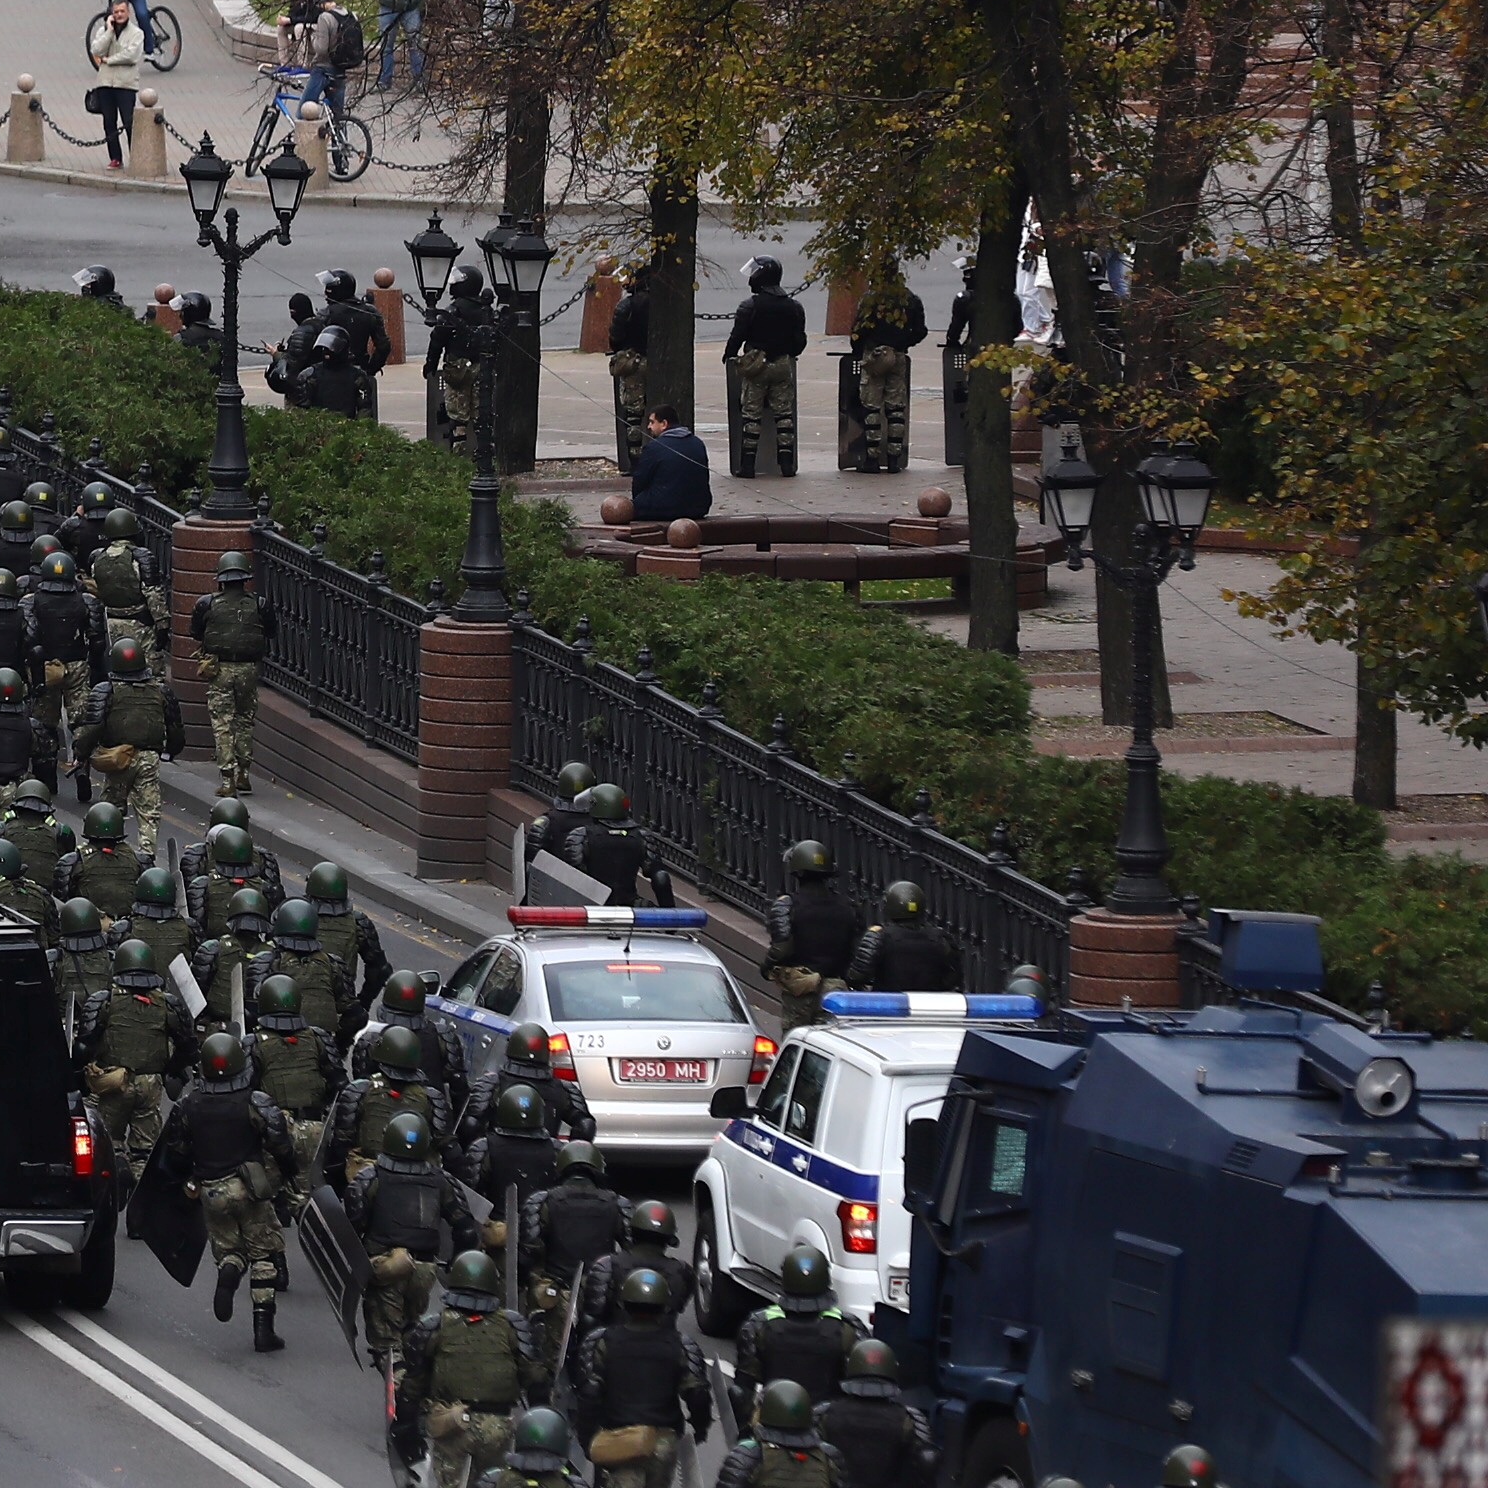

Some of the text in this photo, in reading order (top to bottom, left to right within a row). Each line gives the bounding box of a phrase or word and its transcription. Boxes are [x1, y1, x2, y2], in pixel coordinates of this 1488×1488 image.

[578, 1034, 605, 1048] 723
[626, 1062, 701, 1078] 2950 MH
